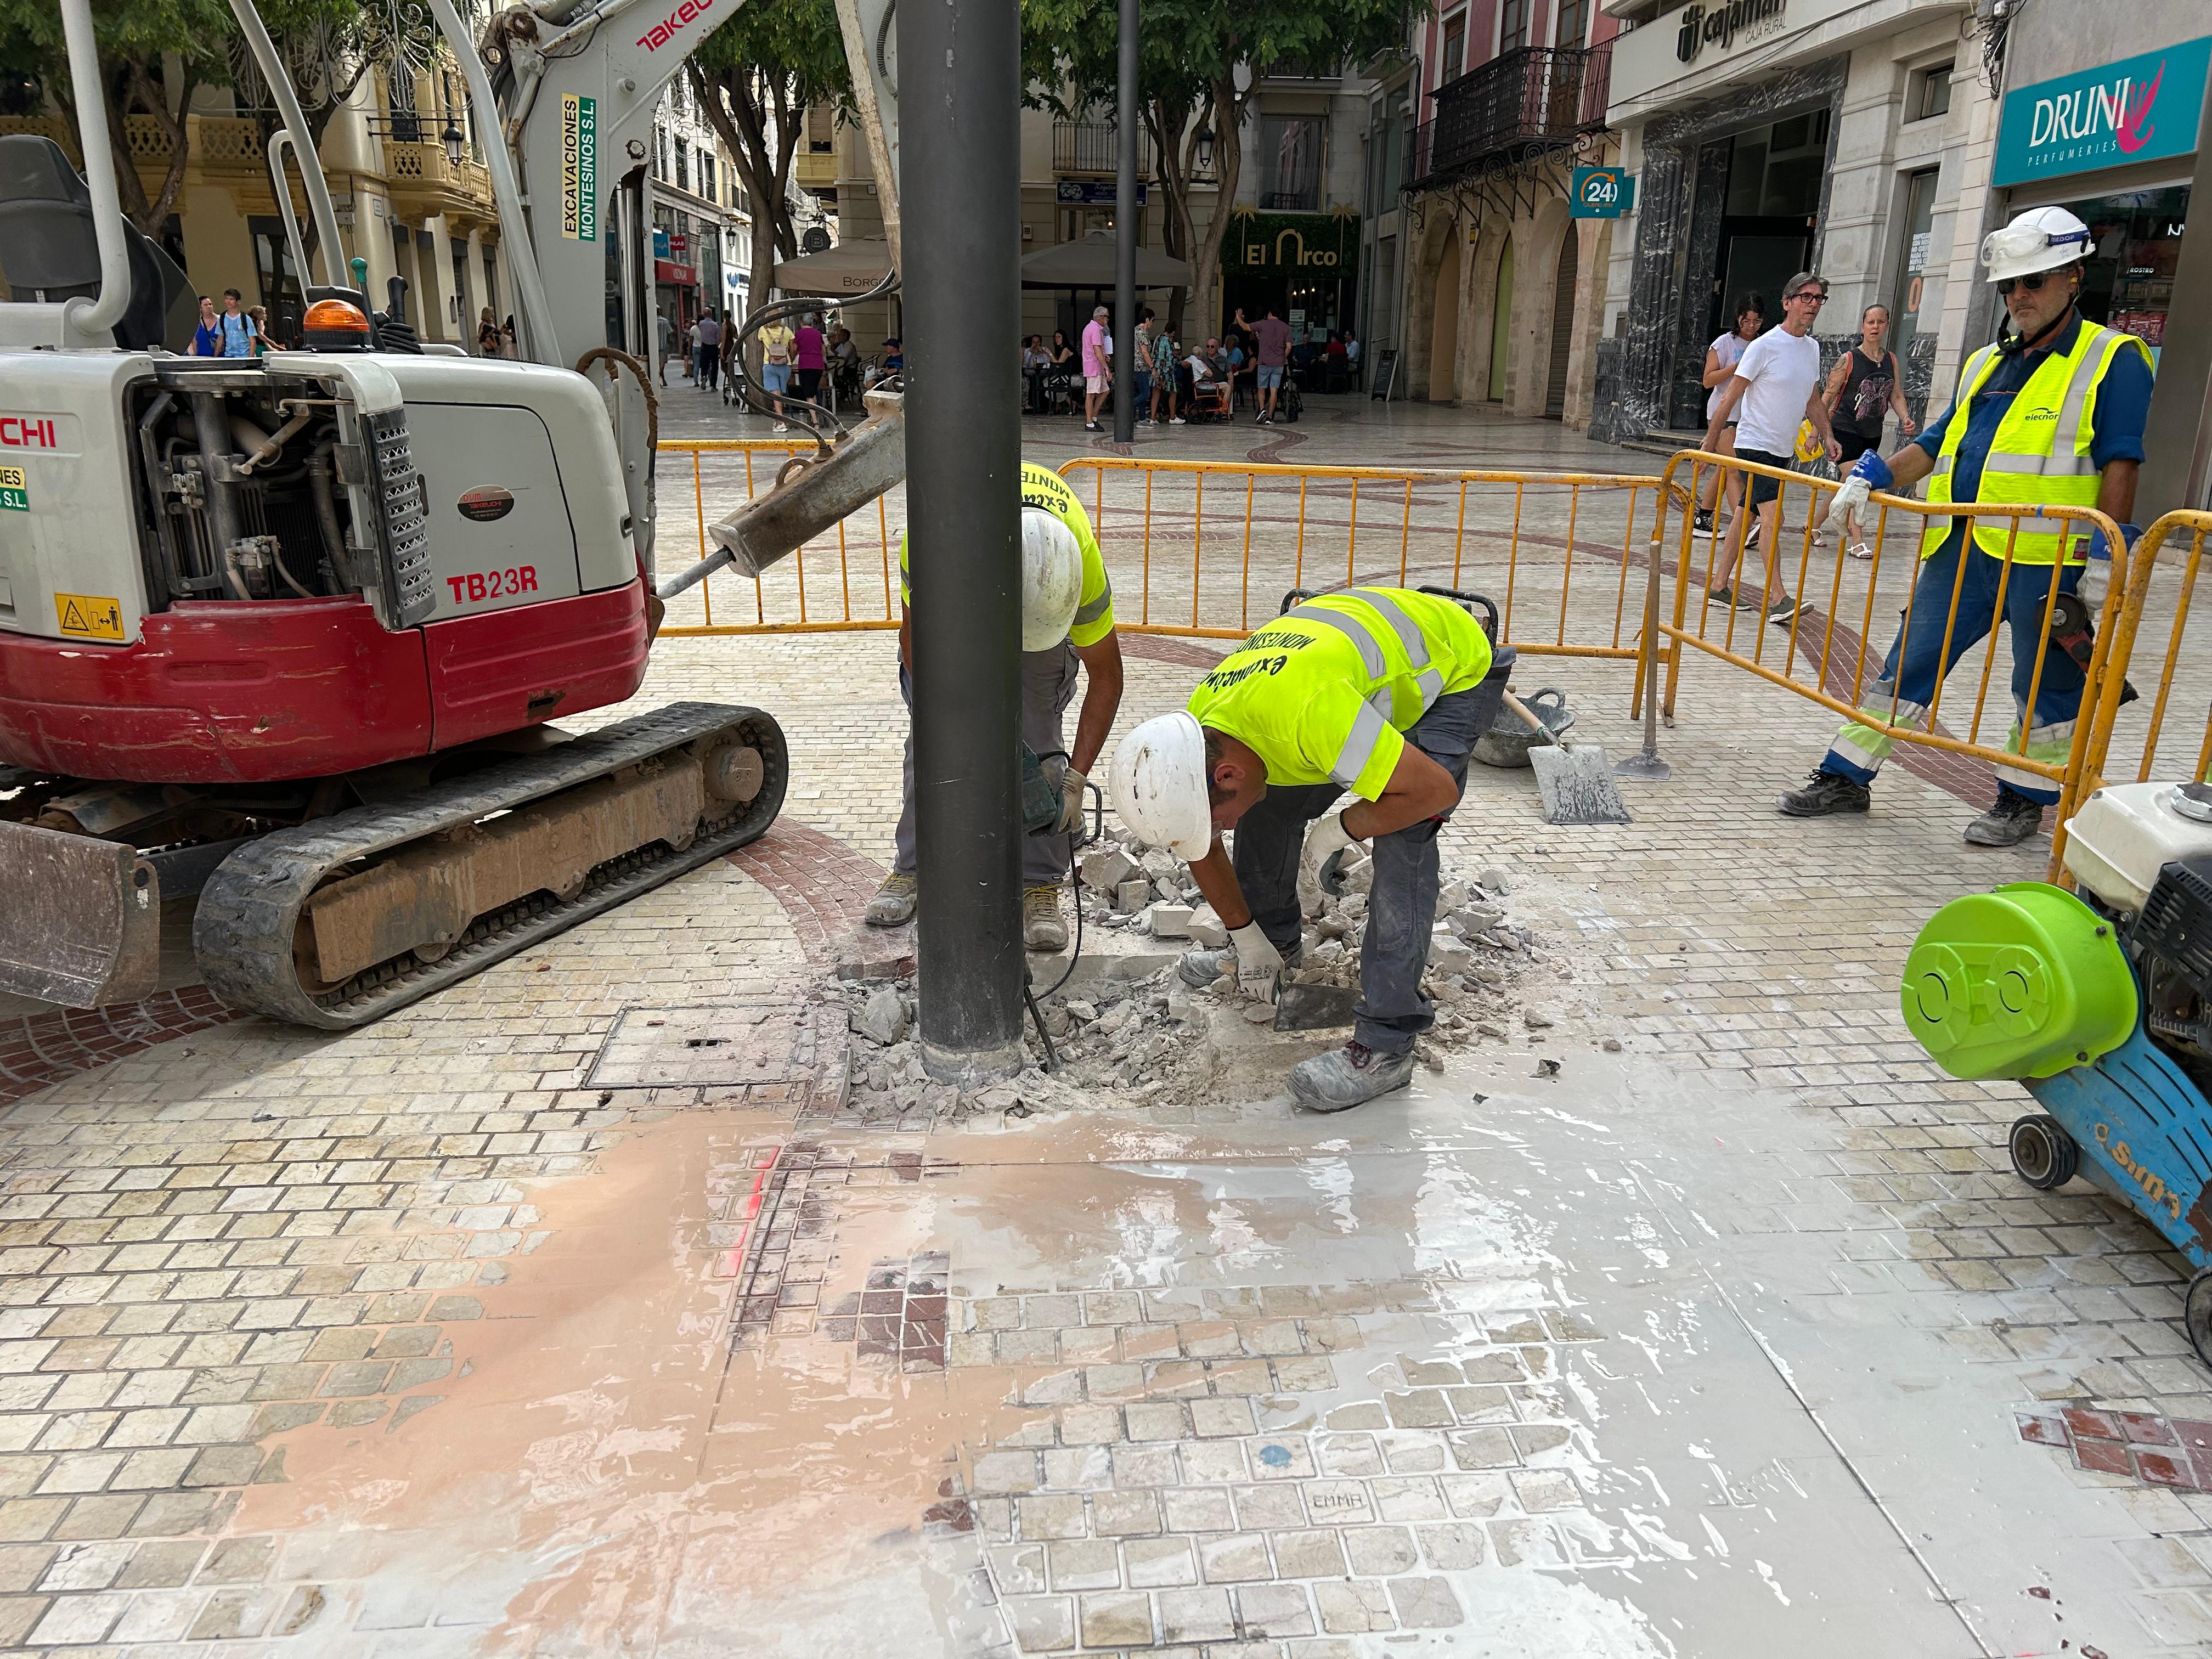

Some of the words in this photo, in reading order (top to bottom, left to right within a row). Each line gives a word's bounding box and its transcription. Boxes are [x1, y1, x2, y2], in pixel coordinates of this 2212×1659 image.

[1745, 30, 1762, 44] CAJA
[1764, 18, 1787, 36] RURAL
[581, 101, 594, 130] S.L.
[2029, 77, 2131, 148] DRUNI
[565, 100, 577, 233] EXCAVACIONES
[2028, 140, 2117, 167] PERFUMERIES
[581, 133, 594, 238] MONTESINOS
[1247, 244, 1266, 265] El
[0, 417, 56, 448] CHI
[3, 490, 27, 508] S.L.
[447, 565, 538, 604] TB23R
[1312, 1493, 1364, 1508] EMMA
